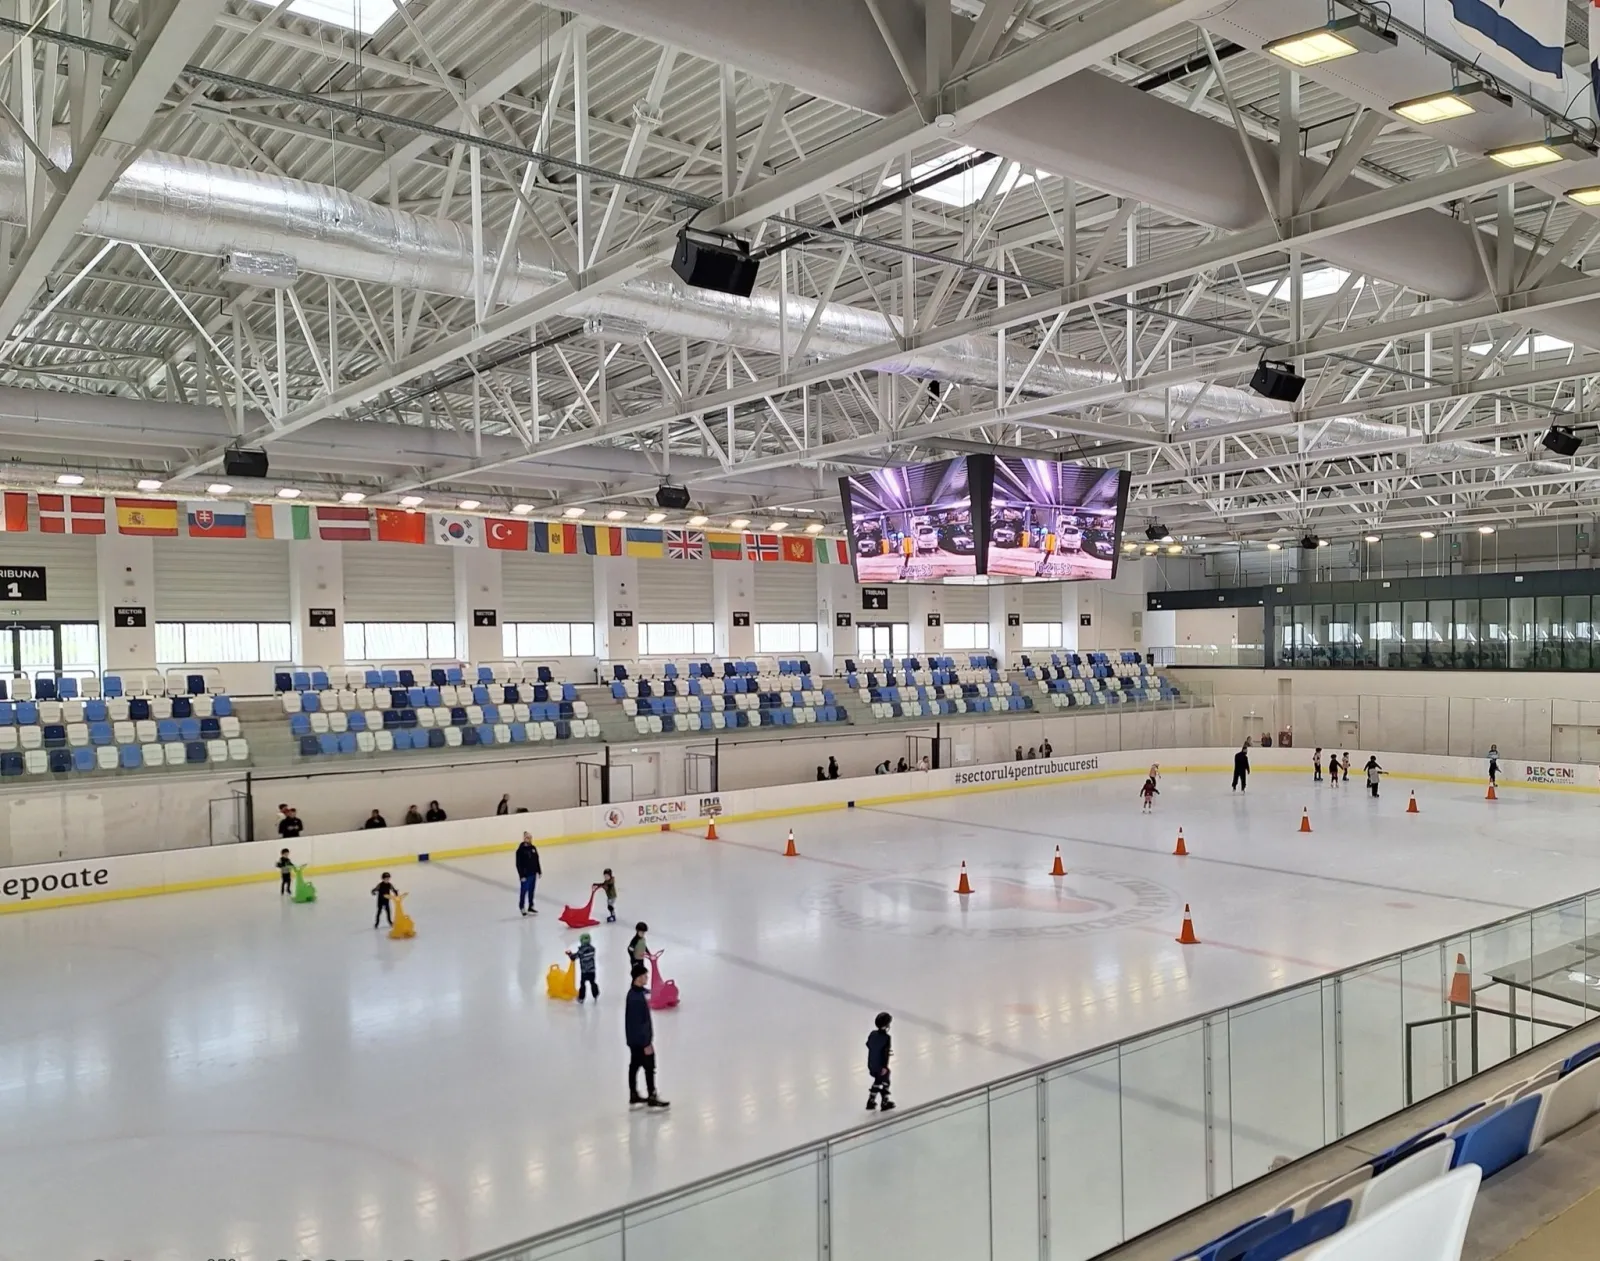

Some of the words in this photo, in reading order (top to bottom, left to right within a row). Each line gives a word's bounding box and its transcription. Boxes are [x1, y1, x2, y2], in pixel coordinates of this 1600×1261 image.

[7, 582, 22, 597] 1
[872, 597, 879, 608] 1
[127, 616, 135, 626] 5
[319, 616, 327, 625] 4
[482, 617, 489, 625] 4
[620, 618, 627, 626] 3
[955, 756, 1099, 784] #sectorul4pentrubucuresti
[1527, 776, 1555, 784] ARENA
[638, 815, 668, 825] ARENA
[0, 868, 108, 900] epoate
